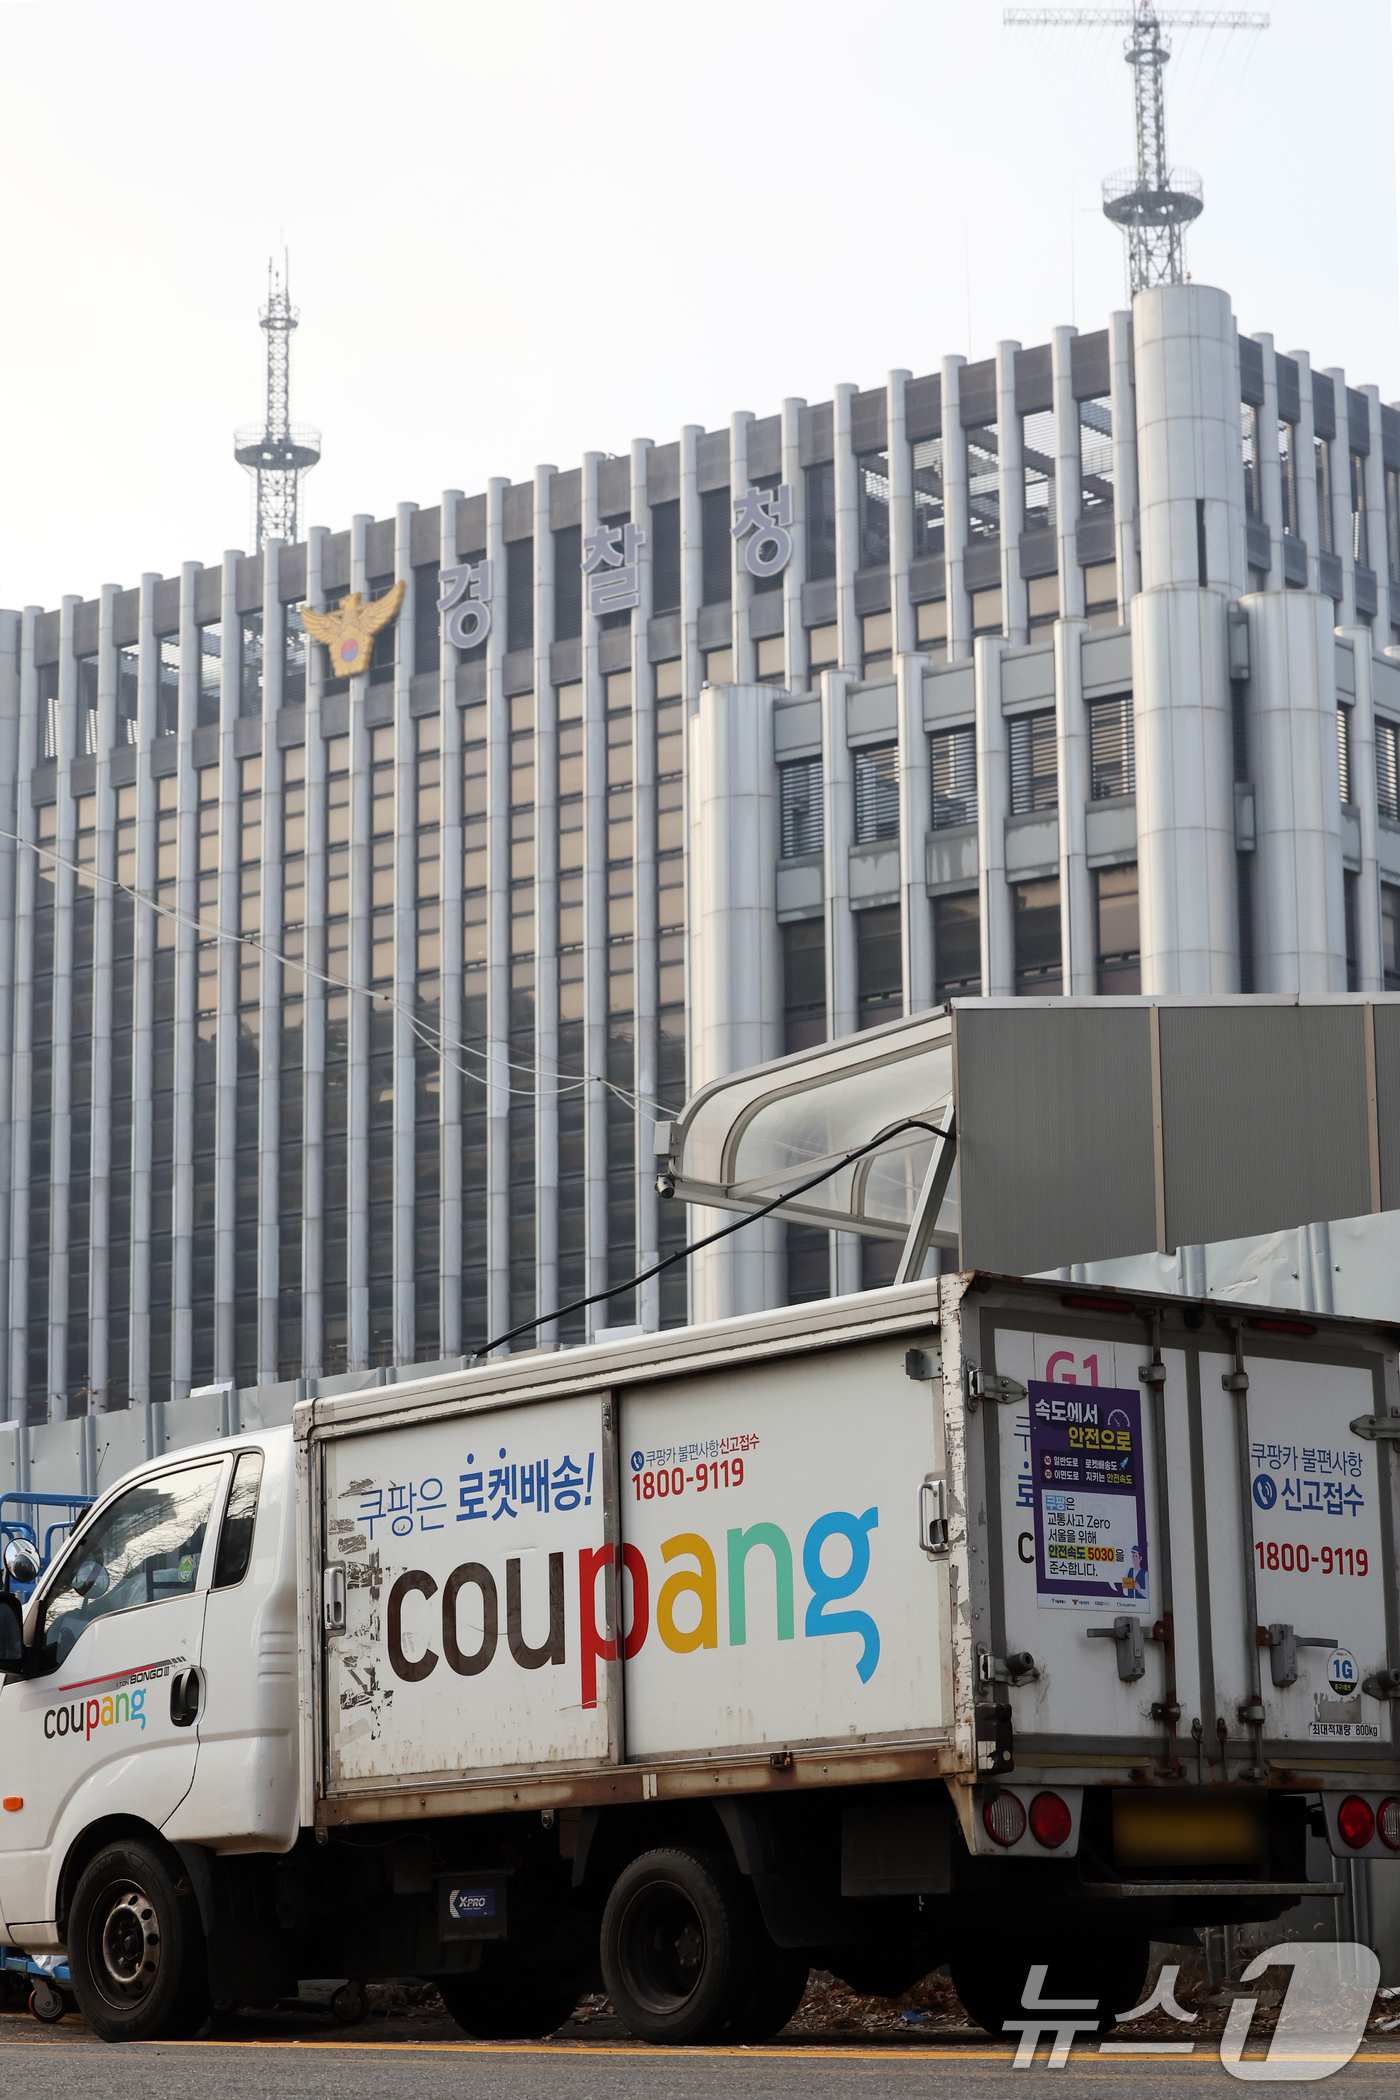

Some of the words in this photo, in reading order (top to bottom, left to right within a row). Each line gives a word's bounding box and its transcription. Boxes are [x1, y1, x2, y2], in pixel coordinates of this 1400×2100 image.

[437, 484, 793, 649] 경찰청
[1046, 1351, 1098, 1387] G1
[1035, 1399, 1098, 1425] 속도에서
[1068, 1426, 1132, 1452] 안전으로
[646, 1447, 677, 1467] 쿠팡카
[1053, 1456, 1079, 1467] 일반도로
[1085, 1459, 1118, 1471] 로켓배송도
[1251, 1443, 1298, 1472] 쿠팡카
[1301, 1447, 1364, 1478] 불편사항
[632, 1457, 744, 1501] 1800-9119
[1054, 1469, 1079, 1481] 이면도로
[1085, 1471, 1106, 1482] 지키는
[1106, 1473, 1133, 1485] 안전속도
[357, 1477, 447, 1540] 쿠팡은
[456, 1448, 595, 1521] 로켓배송!
[1046, 1495, 1075, 1511] 쿠팡은
[1281, 1478, 1365, 1517] 신고접수
[1047, 1512, 1084, 1528] 교통사고
[1086, 1515, 1111, 1529] Zero
[1048, 1528, 1076, 1544] 서울을
[1078, 1530, 1097, 1545] 위해
[1048, 1544, 1086, 1560] 안전속도
[1087, 1547, 1114, 1562] 5030
[1115, 1548, 1125, 1563] 을
[1255, 1541, 1369, 1577] 1800-9119
[1049, 1560, 1099, 1577] 준수합니다.
[387, 1506, 880, 1709] coupang
[130, 1668, 164, 1685] BONGO
[1333, 1659, 1353, 1679] 1G
[44, 1688, 147, 1741] coupang
[1312, 1723, 1351, 1736] 최대적재량
[1355, 1723, 1378, 1737] 800kg
